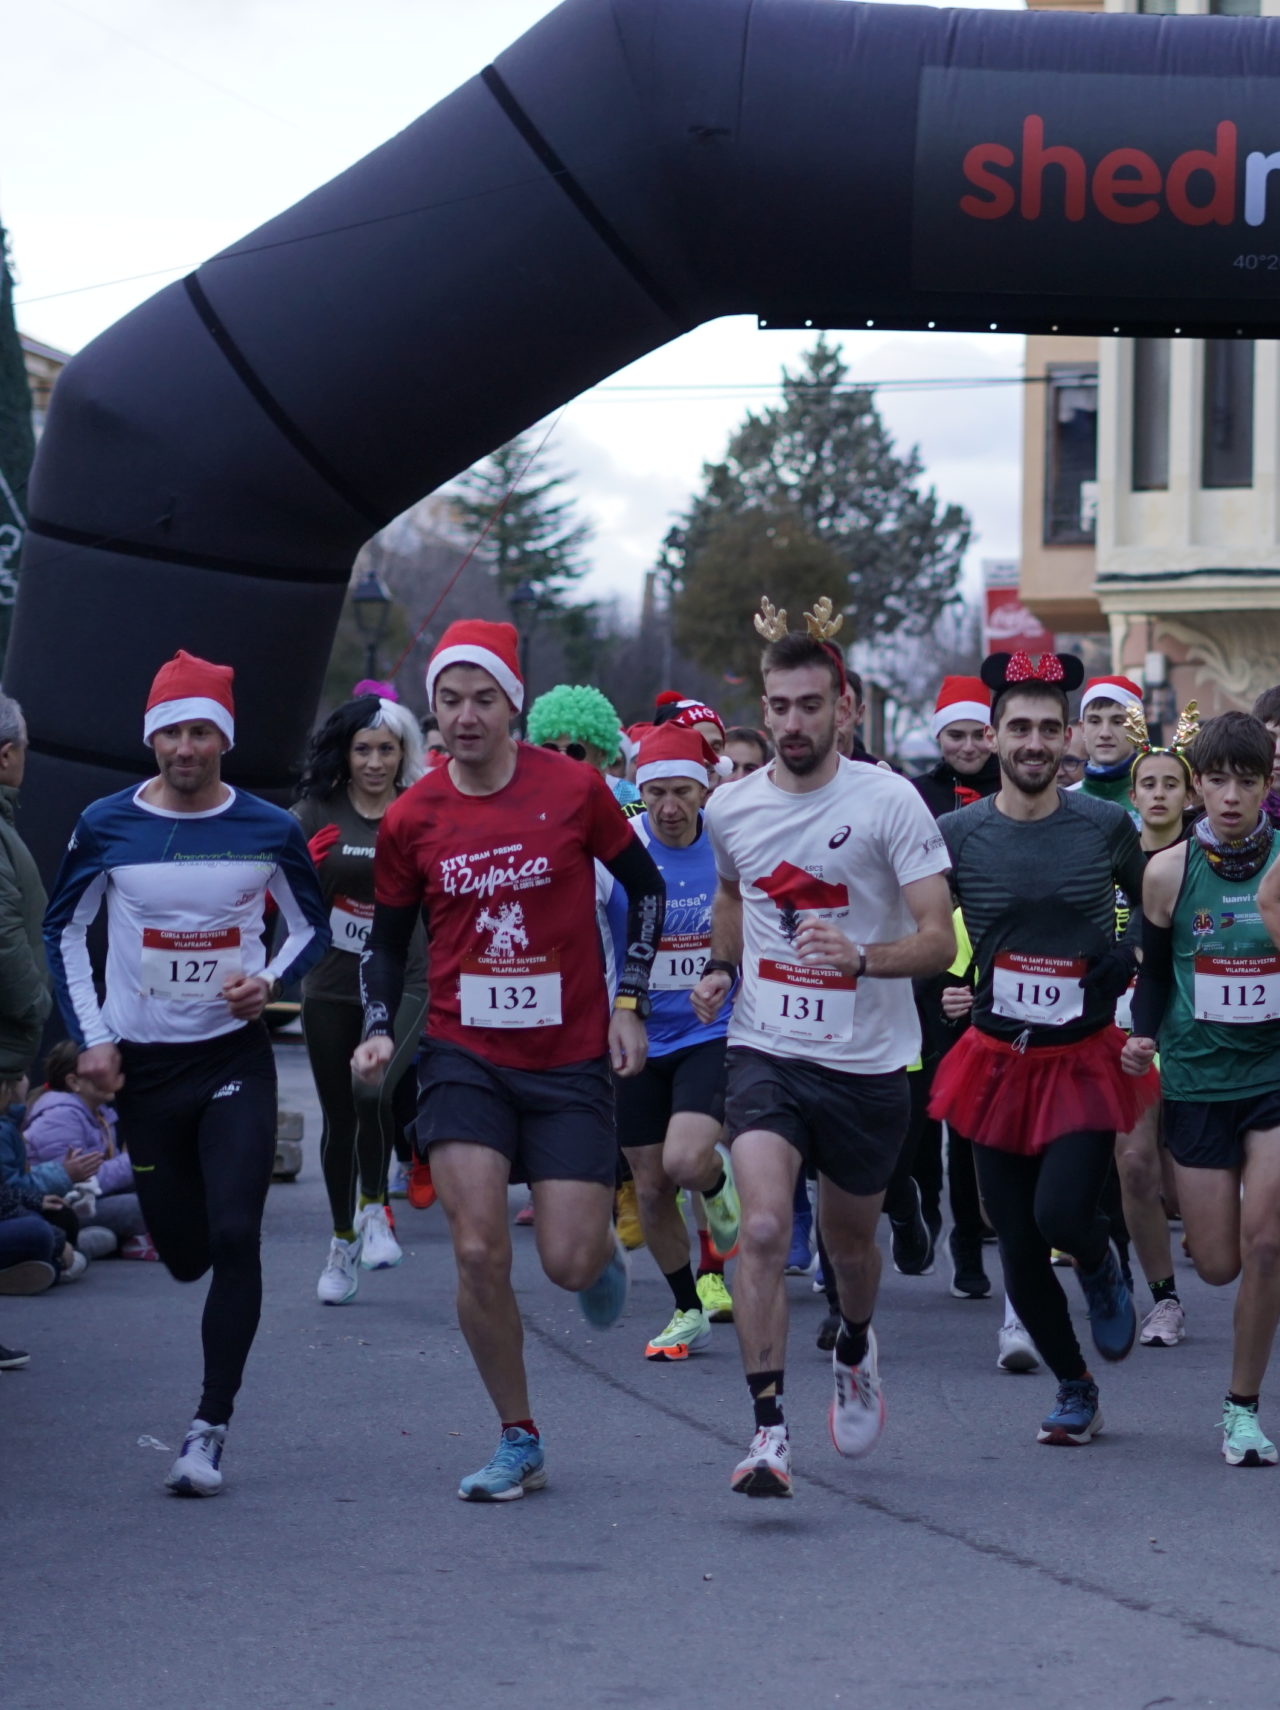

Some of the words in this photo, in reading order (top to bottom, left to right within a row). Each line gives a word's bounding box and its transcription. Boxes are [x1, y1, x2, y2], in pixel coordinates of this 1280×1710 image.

[342, 844, 376, 858] trang
[440, 854, 468, 873] XIV
[469, 850, 490, 862] GRAN
[493, 843, 523, 856] PREMIO
[161, 931, 180, 939] CURSA
[182, 931, 198, 939] SANT
[200, 930, 228, 938] SILVESTRE
[517, 956, 546, 964] SILVESTRE
[669, 957, 706, 976] 103
[1009, 954, 1027, 962] CURSA
[1045, 958, 1073, 967] SILVESTRE
[1249, 957, 1276, 965] SILVESTRE
[169, 960, 218, 982] 127
[775, 963, 793, 972] CURSA
[794, 966, 810, 975] SANT
[811, 968, 842, 977] SILVESTRE
[1021, 964, 1056, 974] VILAFRANCA
[786, 975, 824, 985] VILAFRANCA
[488, 986, 537, 1009] 132
[1016, 982, 1060, 1006] 119
[1221, 984, 1266, 1006] 112
[779, 994, 825, 1022] 131
